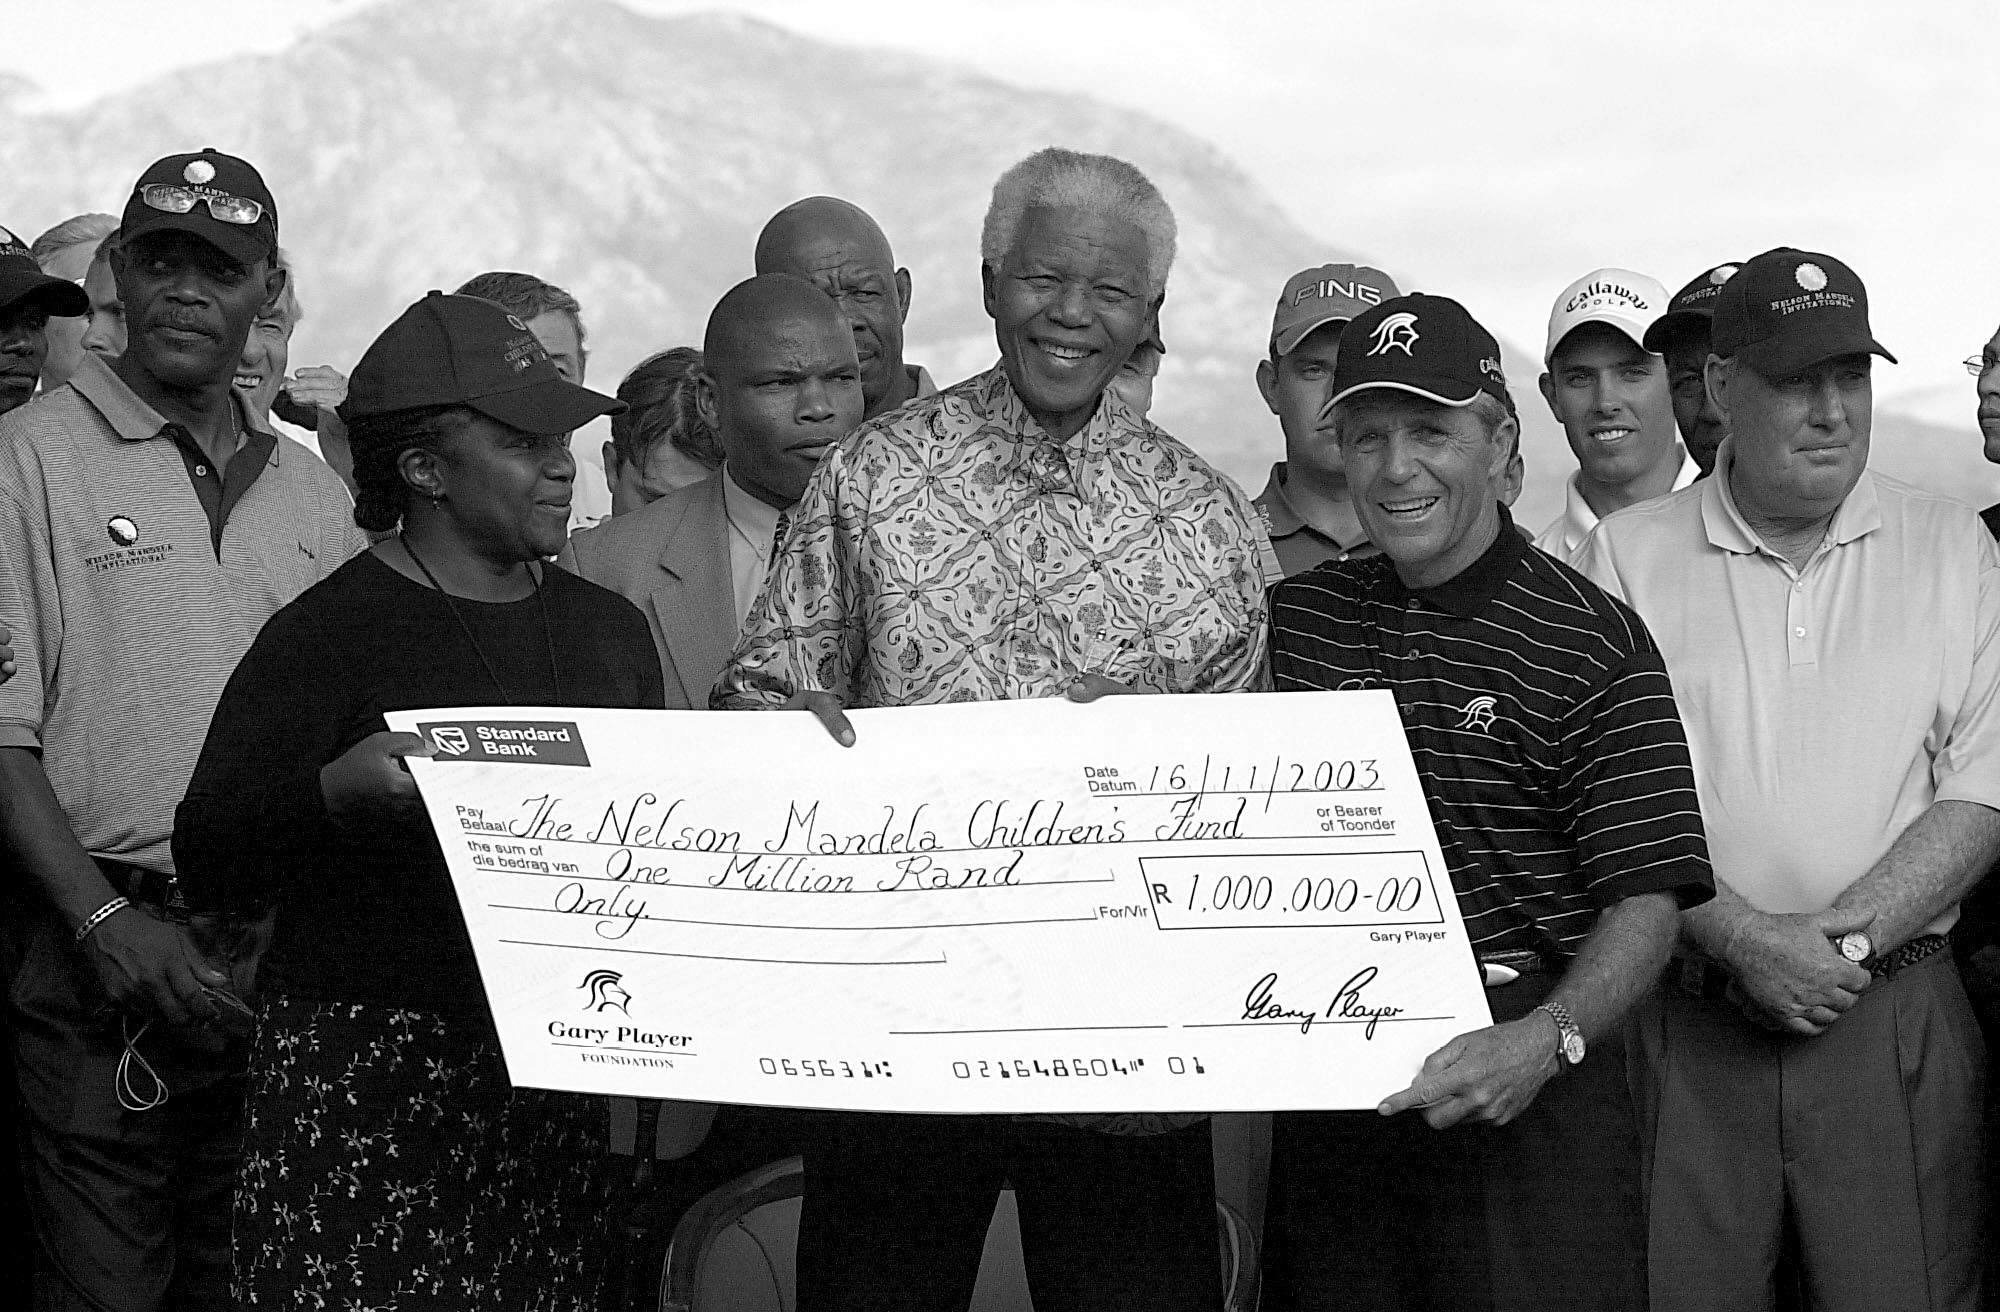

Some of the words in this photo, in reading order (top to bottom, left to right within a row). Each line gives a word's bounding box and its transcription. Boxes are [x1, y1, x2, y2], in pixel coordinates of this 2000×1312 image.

[1294, 279, 1382, 307] PING
[1566, 281, 1648, 312] Callaway
[1581, 298, 1626, 309] GOLF
[476, 726, 570, 742] Standard
[483, 741, 537, 756] Bank
[1085, 766, 1119, 778] Date
[1089, 780, 1137, 792] Datum
[456, 805, 484, 819] Pay
[1316, 808, 1330, 817] or
[1335, 805, 1382, 817] Bearer
[460, 818, 507, 832] Betaal
[508, 794, 573, 841] The
[586, 793, 740, 851] Nelson
[764, 800, 944, 854] Mandela
[968, 799, 1125, 849] Children's
[1155, 793, 1247, 841] Fund
[1320, 820, 1334, 831] of
[1337, 819, 1396, 831] Toonder
[467, 841, 491, 853] the
[495, 844, 526, 855] sum
[529, 846, 543, 856] of
[473, 854, 495, 866] die
[498, 856, 549, 873] bedrag
[552, 862, 579, 873] van
[606, 849, 670, 884] One
[708, 854, 853, 893] Million
[877, 850, 1023, 891] Rand
[1152, 884, 1172, 904] R
[1100, 905, 1148, 918] For/Vir
[1370, 931, 1401, 943] Gary
[1405, 930, 1446, 943] Player
[1241, 973, 1316, 1034] Gary
[1326, 966, 1404, 1041] Player
[548, 1021, 609, 1043] Gary
[617, 1026, 692, 1047] Player
[581, 1053, 674, 1068] FOUNDATION
